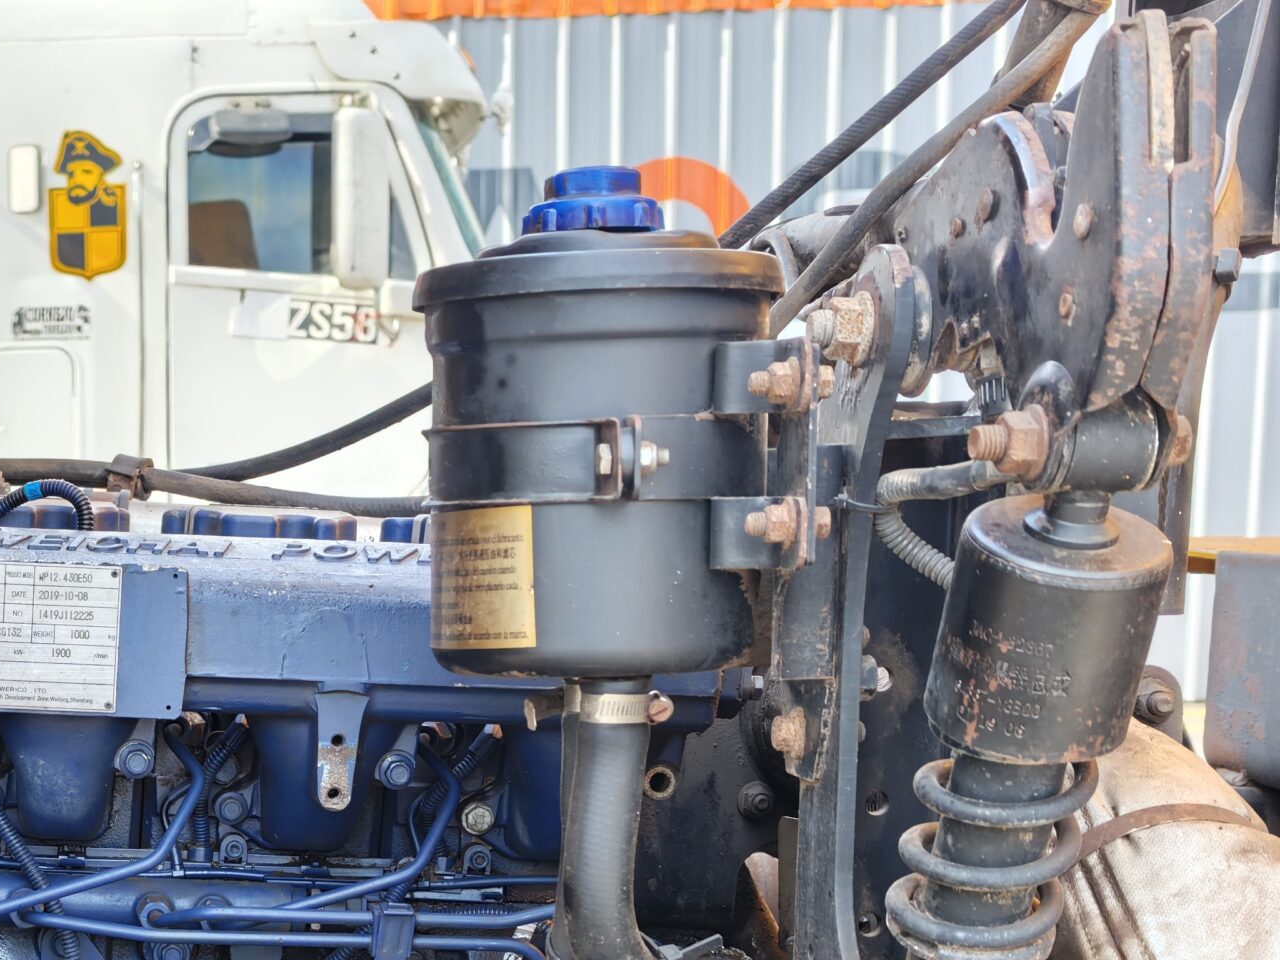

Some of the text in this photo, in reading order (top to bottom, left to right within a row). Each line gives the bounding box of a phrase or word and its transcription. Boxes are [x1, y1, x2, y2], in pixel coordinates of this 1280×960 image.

[39, 573, 93, 583] WP12.430E50
[38, 591, 89, 602] 2019-10-08
[39, 609, 94, 621] 1419J112225
[70, 630, 90, 640] 1000
[51, 648, 71, 658] 1900
